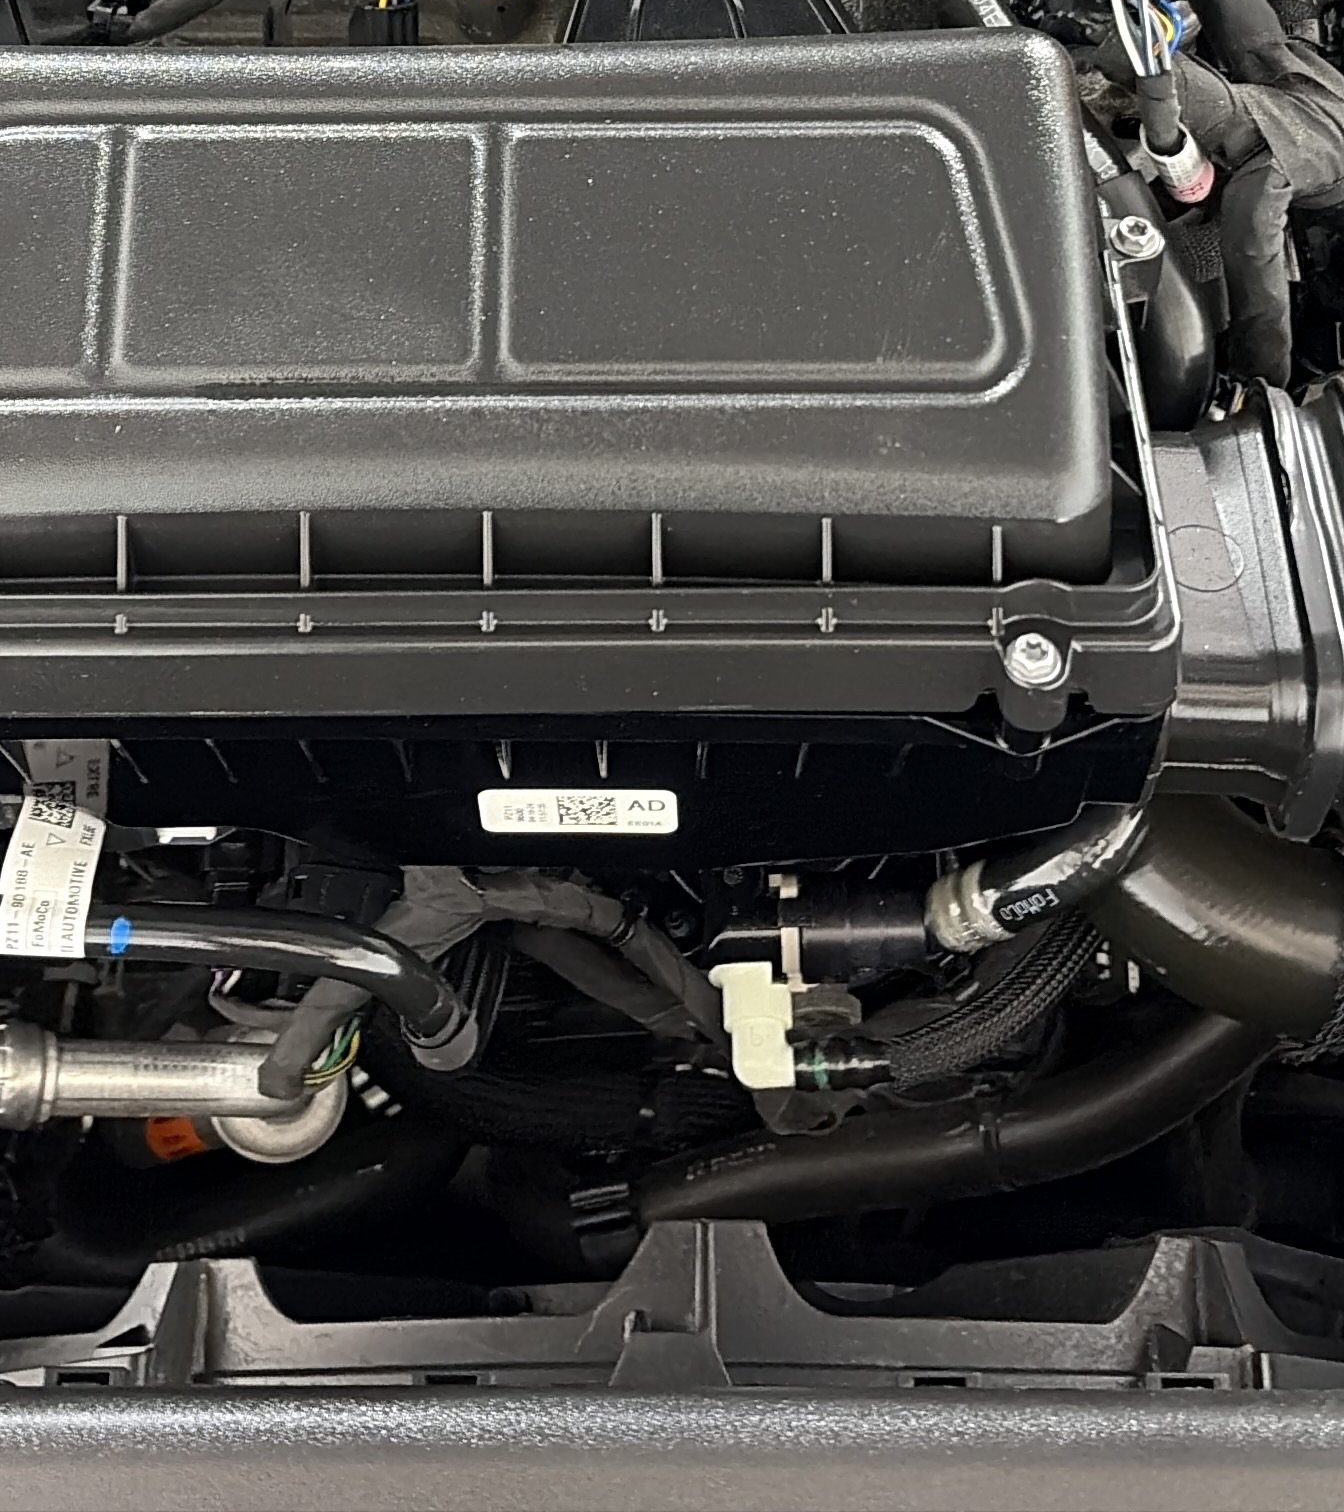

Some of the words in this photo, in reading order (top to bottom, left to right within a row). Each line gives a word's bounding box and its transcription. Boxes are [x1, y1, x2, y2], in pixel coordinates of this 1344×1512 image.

[627, 799, 666, 811] AD
[29, 898, 51, 947] FoMoCo
[60, 860, 87, 941] AUTOMOTIVE
